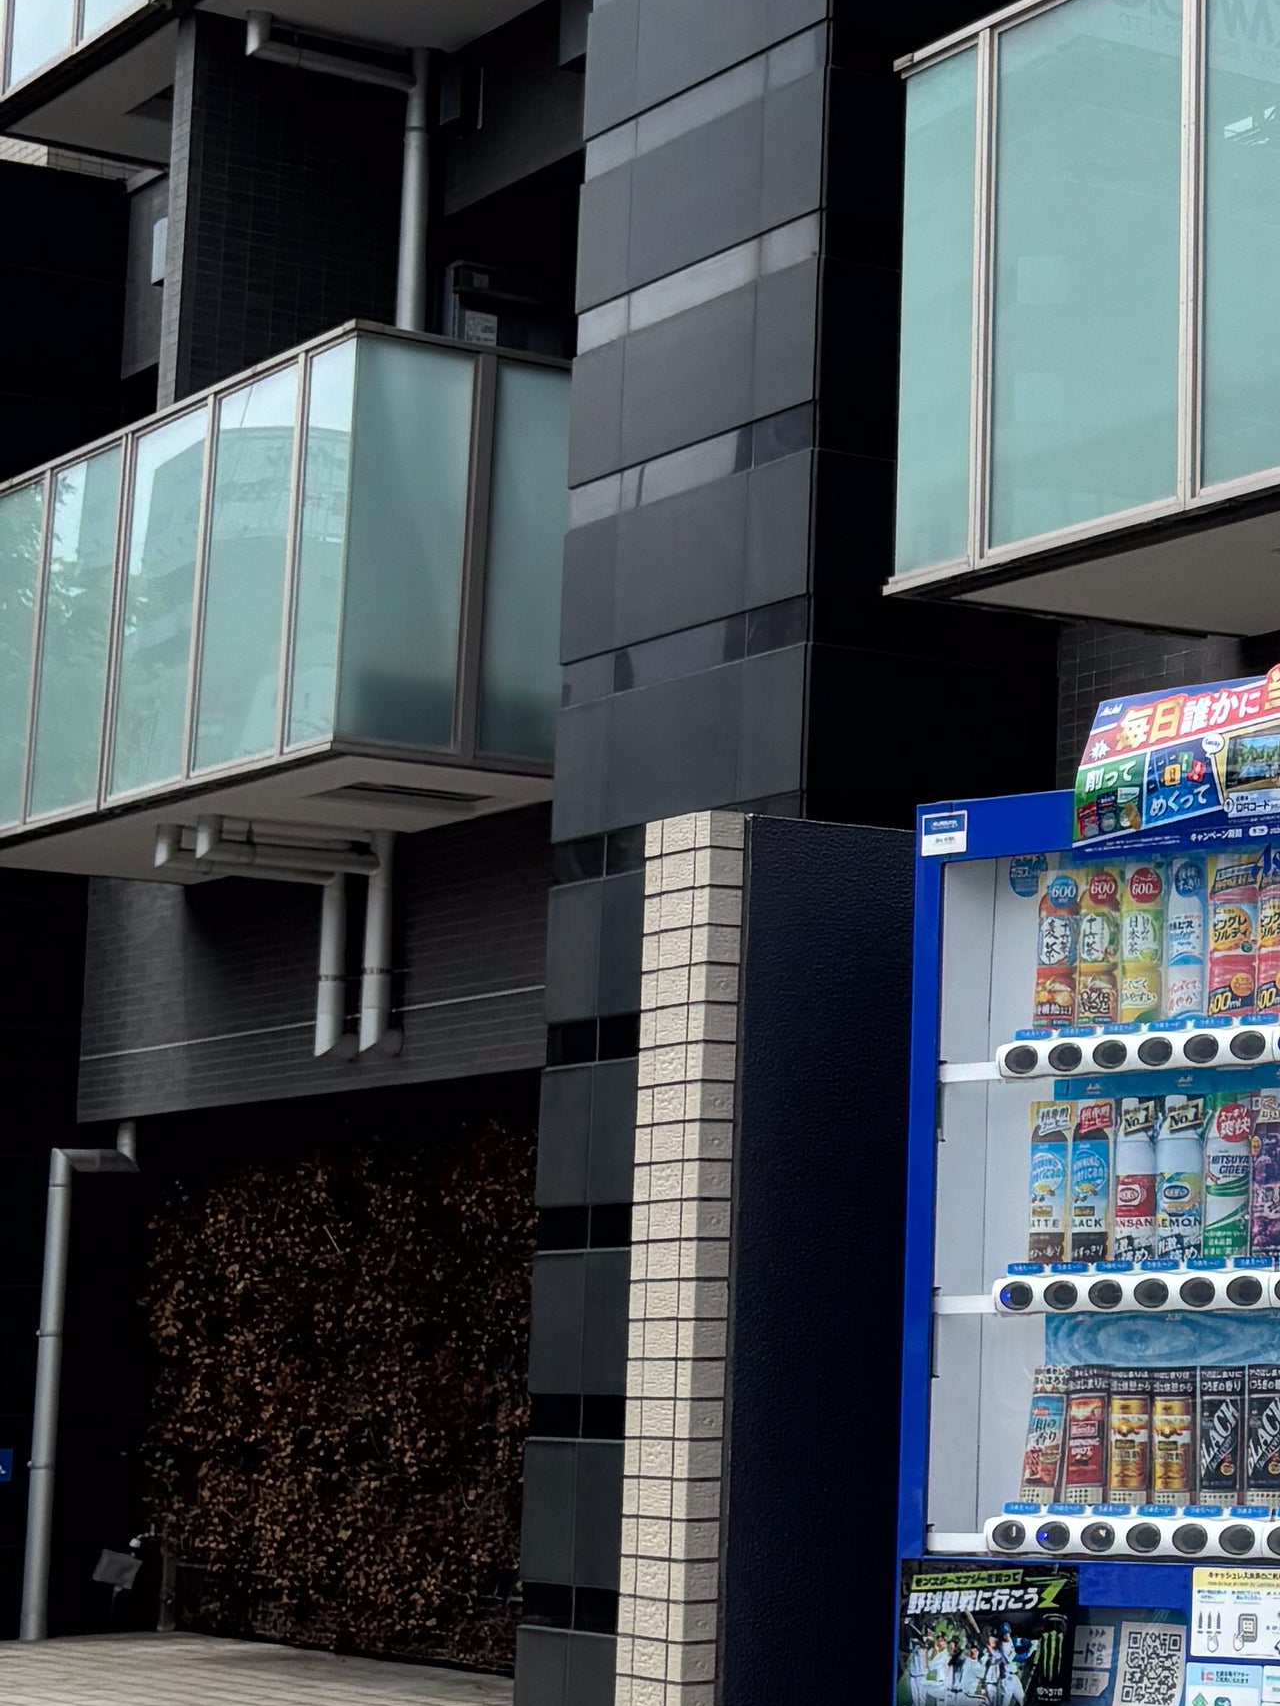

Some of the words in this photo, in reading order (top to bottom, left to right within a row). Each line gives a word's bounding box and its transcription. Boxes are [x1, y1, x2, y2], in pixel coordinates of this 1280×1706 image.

[1086, 761, 1136, 792] 削って
[1149, 787, 1208, 816] めくって
[1052, 886, 1076, 898] 600
[1091, 882, 1116, 895] 600
[1131, 883, 1153, 895] 600
